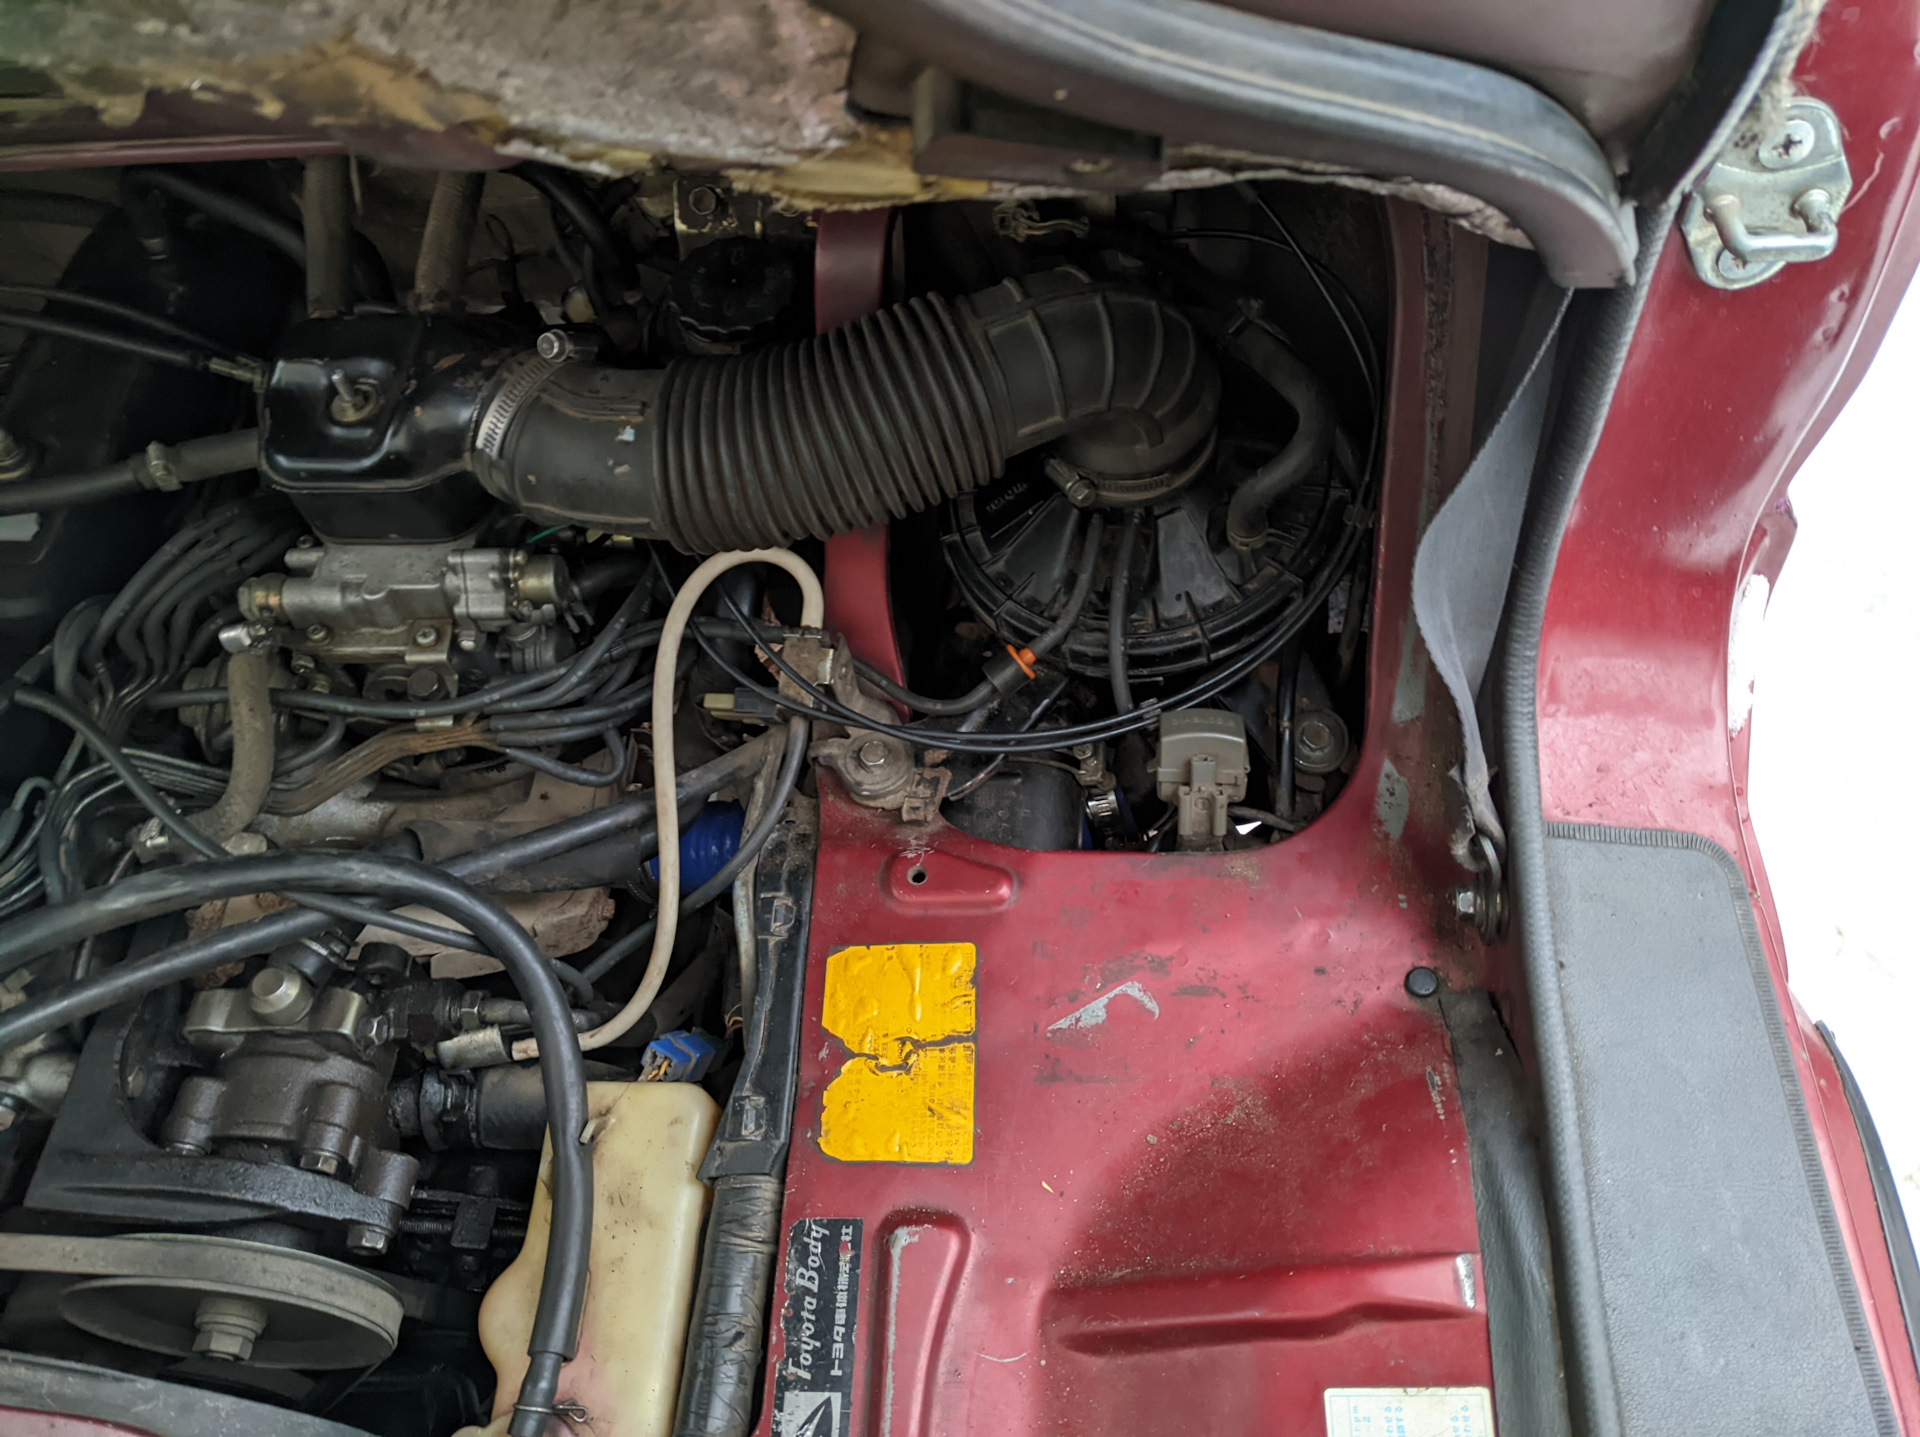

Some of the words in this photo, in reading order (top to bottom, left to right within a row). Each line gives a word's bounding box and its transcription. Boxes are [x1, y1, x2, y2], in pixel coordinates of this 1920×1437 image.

[795, 1224, 829, 1293] Body
[830, 1225, 853, 1377] トヨタ車体株式社
[787, 1296, 821, 1381] Toyota
